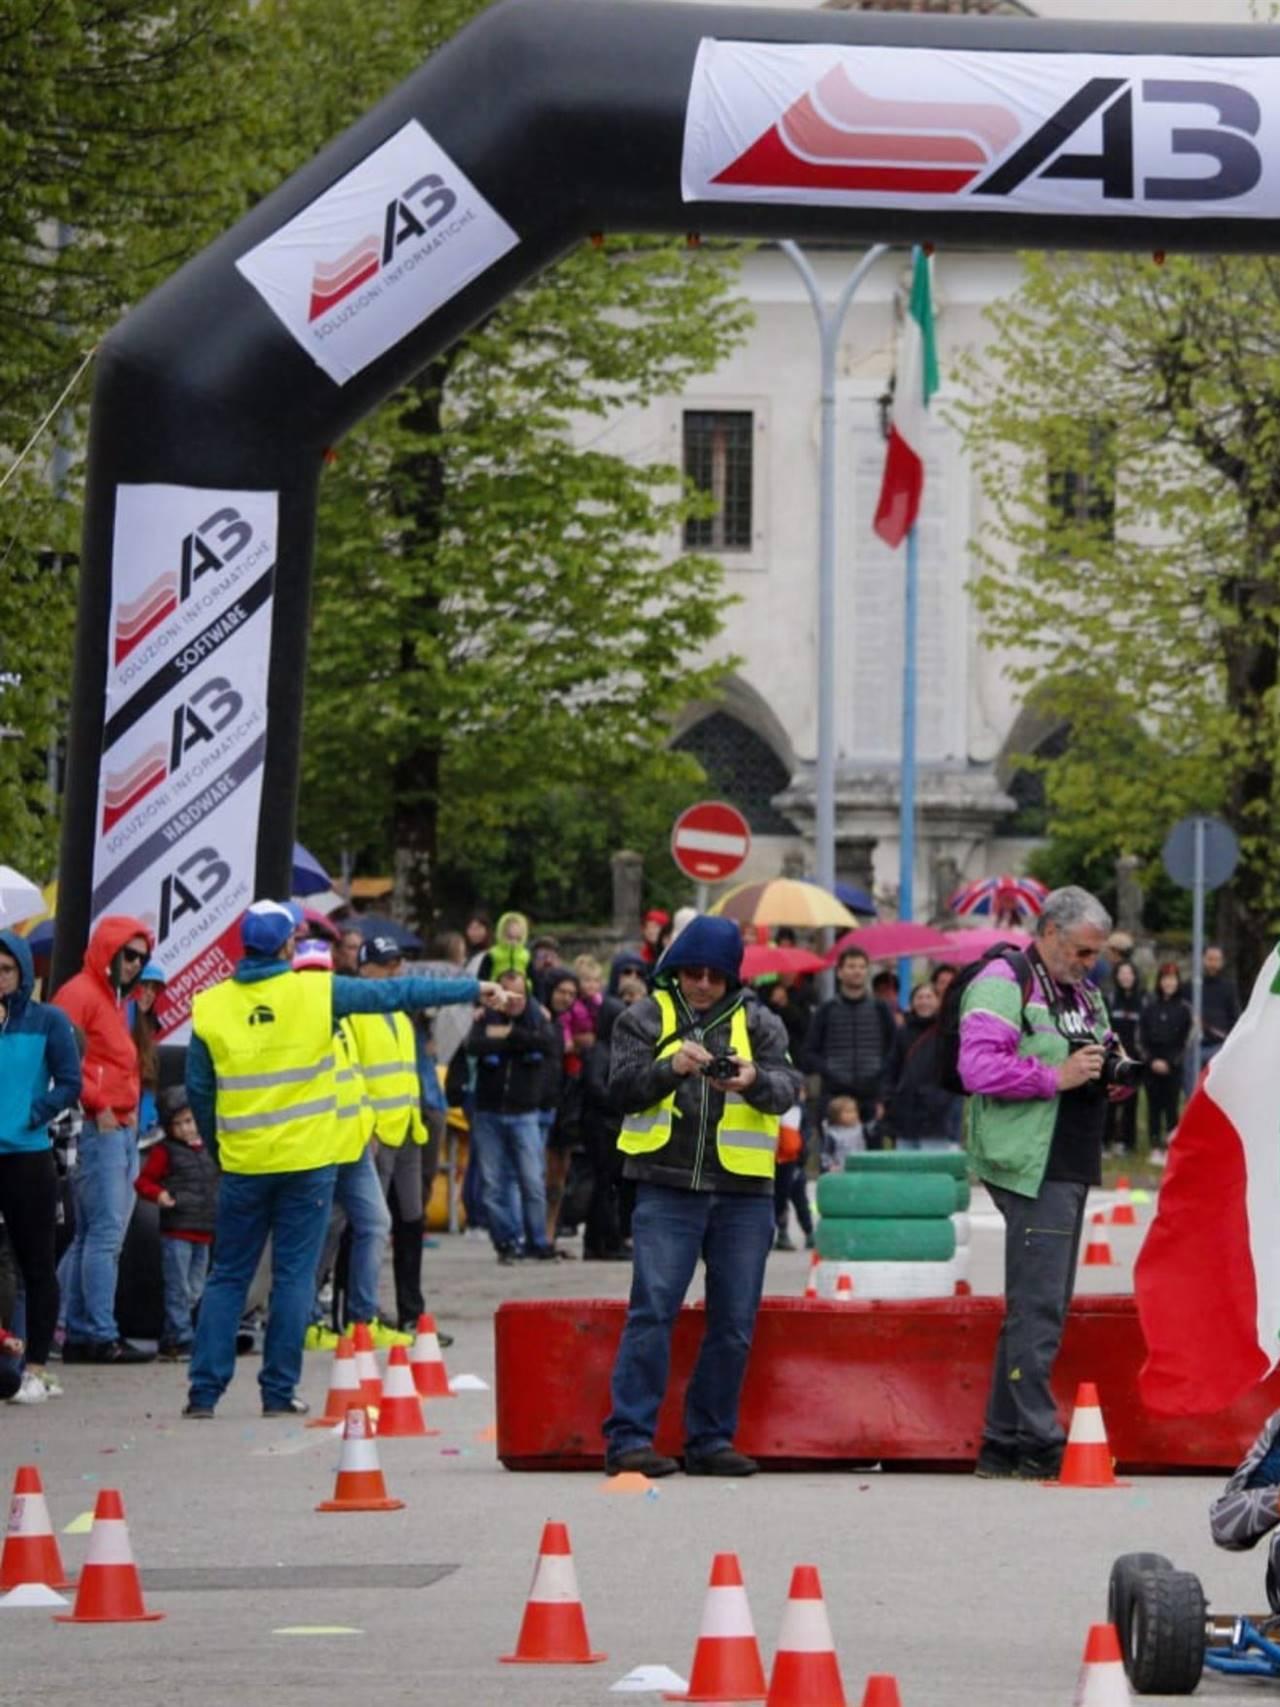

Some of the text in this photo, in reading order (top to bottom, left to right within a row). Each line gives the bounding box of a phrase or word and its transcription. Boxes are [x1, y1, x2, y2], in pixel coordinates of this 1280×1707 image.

[970, 77, 1262, 201] A3
[382, 173, 458, 268] A3
[314, 209, 477, 341] SOLUZIONI INFORMATICHE
[180, 507, 254, 603] A3
[119, 540, 270, 686] SOLUZIONI INFORMATICHE
[174, 604, 249, 674] SOFTWARE
[170, 677, 244, 774] A3
[106, 711, 261, 853] SOLUZIONI INFORMATICHE
[162, 772, 239, 842] HARDWARE
[158, 846, 231, 945] A3
[161, 880, 248, 965] INFORMATICHE
[166, 946, 225, 1003] IMPIANTI
